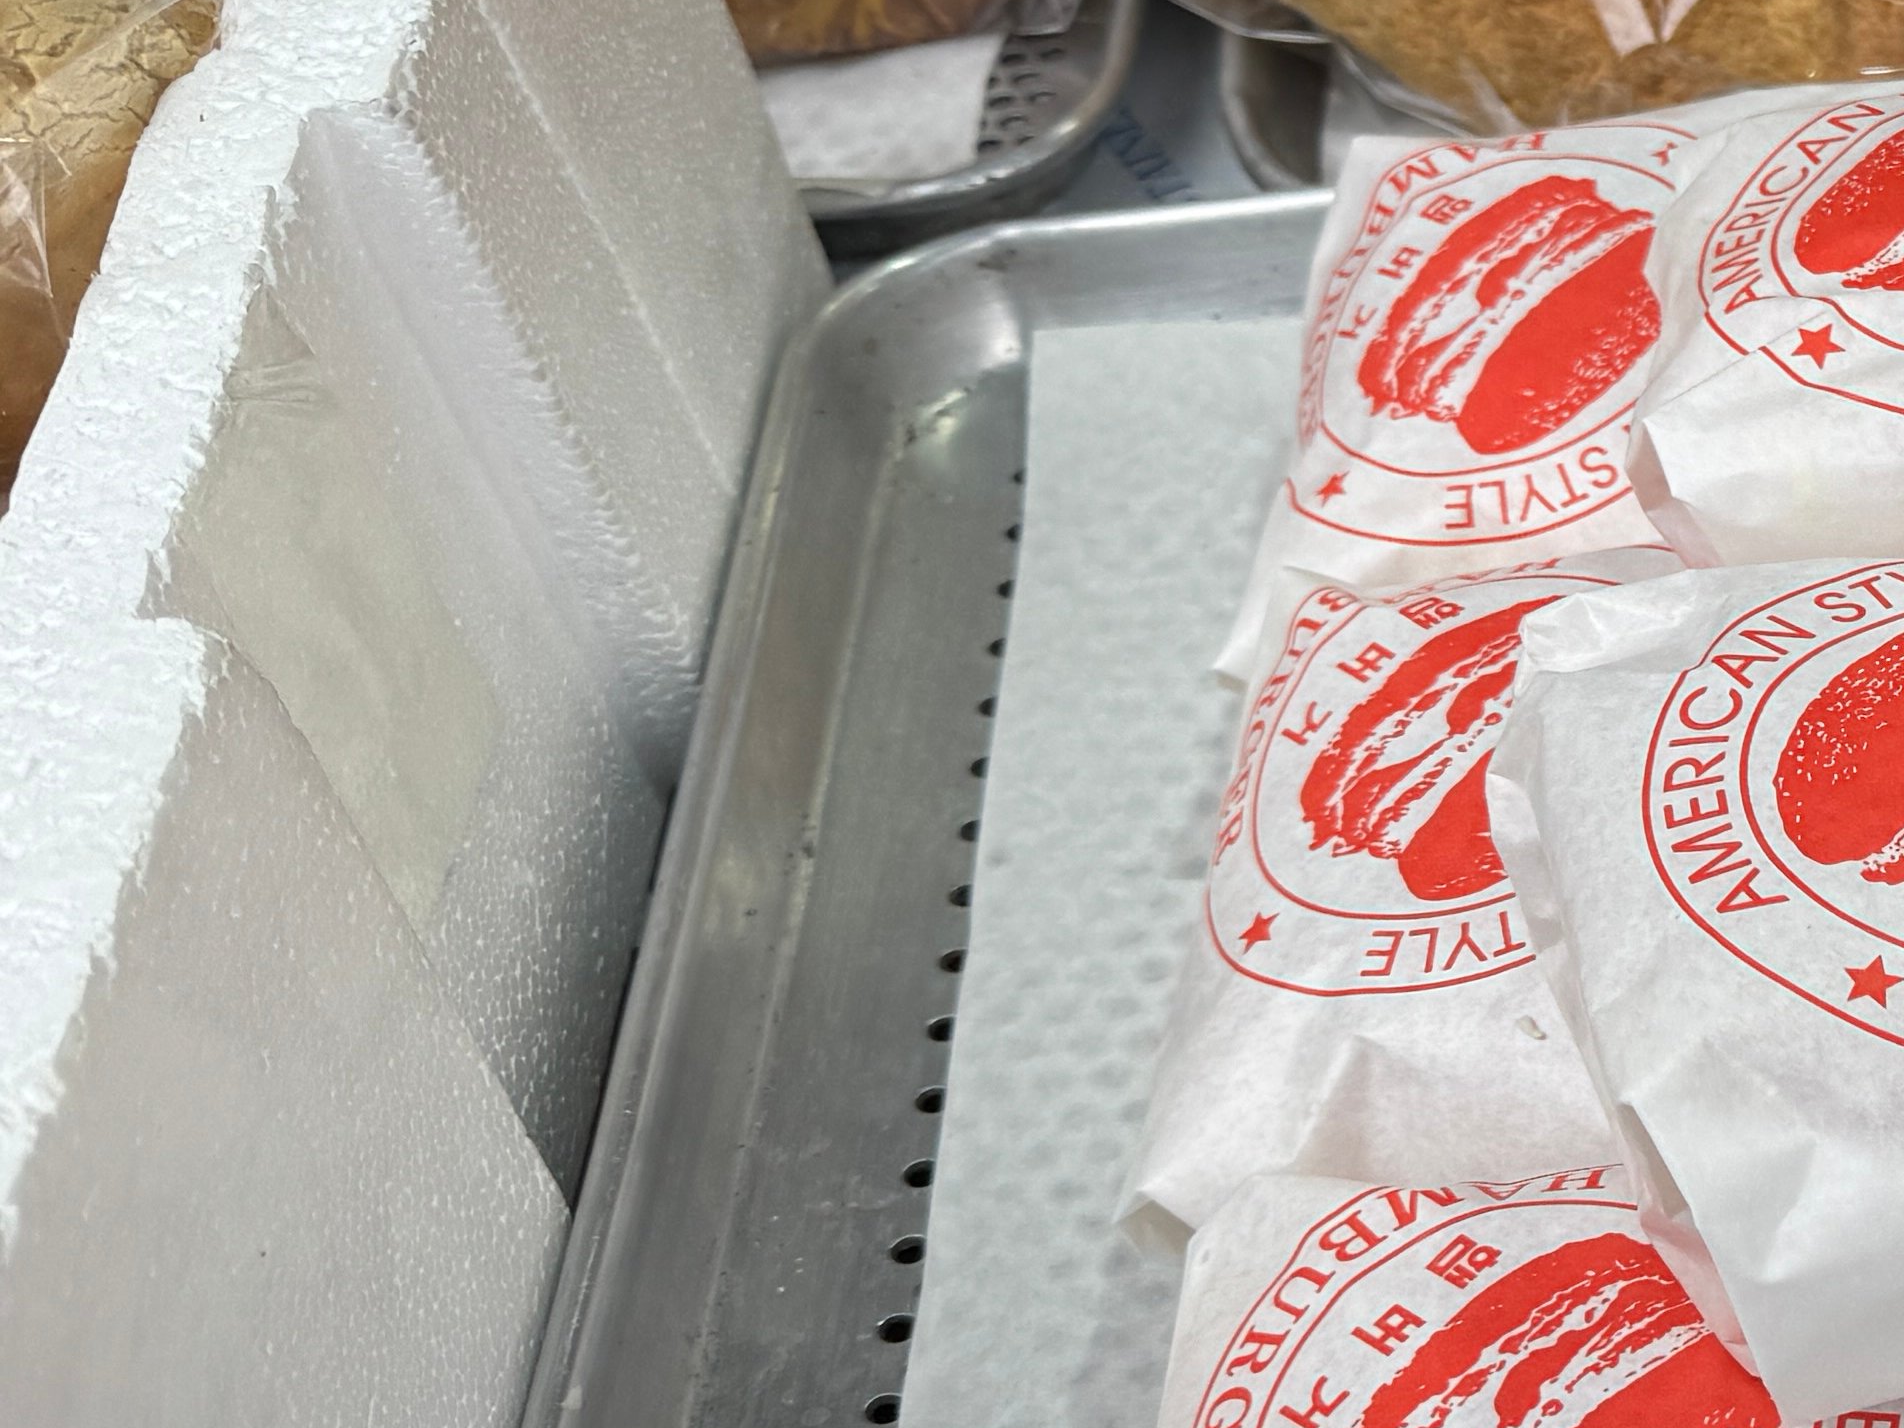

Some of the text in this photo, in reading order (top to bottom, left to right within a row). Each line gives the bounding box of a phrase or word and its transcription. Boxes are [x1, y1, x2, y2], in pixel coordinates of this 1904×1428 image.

[1336, 193, 1474, 340] 햄버거
[1711, 103, 1886, 315] AMERICAN
[1444, 445, 1620, 530] STYLE
[1281, 596, 1466, 746] 햄버거
[1663, 613, 1817, 917] AMERICAN
[1360, 909, 1528, 978] TYLE
